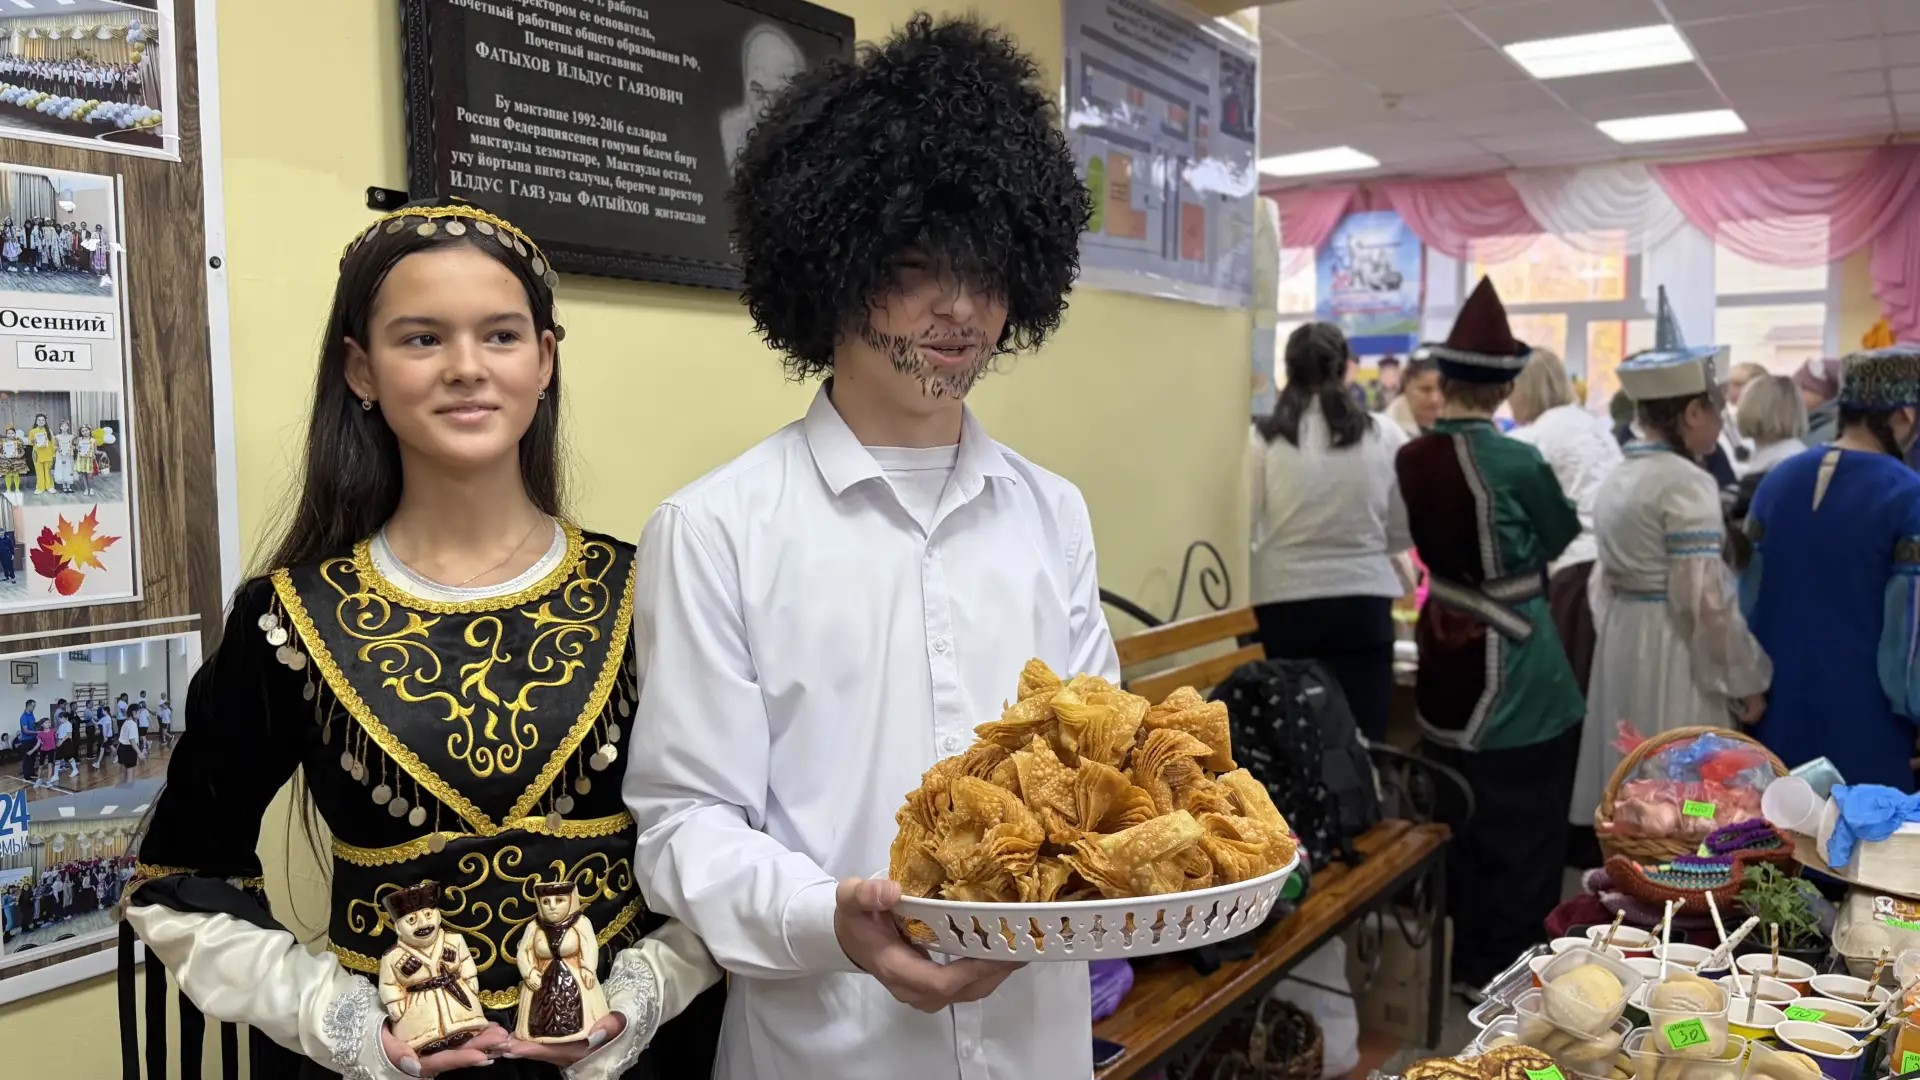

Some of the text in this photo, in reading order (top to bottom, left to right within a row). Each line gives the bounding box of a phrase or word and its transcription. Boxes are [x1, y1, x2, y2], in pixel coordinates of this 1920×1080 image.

[512, 0, 656, 42] ректором ее основатель,
[608, 0, 649, 20] работал
[517, 12, 573, 36] работник
[575, 26, 615, 47] общего
[616, 38, 680, 65] образования
[682, 54, 701, 72] РФ,
[524, 30, 644, 73] Почетный наставник
[475, 41, 684, 105] ФАТЫХОВ ИЛЬДУС ГАЯЗОВИЧ
[456, 106, 500, 128] Россия
[503, 116, 599, 149] Федерациясенең
[601, 138, 641, 156] гомуми
[642, 144, 672, 162] белем
[495, 93, 667, 143] Бу мәктәпне 1992-2016 елларда
[451, 150, 703, 206] уку йортына нигез салучы, беренче директор
[470, 133, 691, 185] мактаулы хезмәткәре, Мактаулы остаз,
[449, 169, 503, 193] ИЛДУС
[509, 179, 545, 200] ГАЯЗ
[548, 190, 572, 204] улы
[577, 190, 649, 215] ФАТЫЙХОВ
[0, 309, 106, 332] Осенний
[34, 344, 76, 362] бал
[1679, 1029, 1699, 1043] 30
